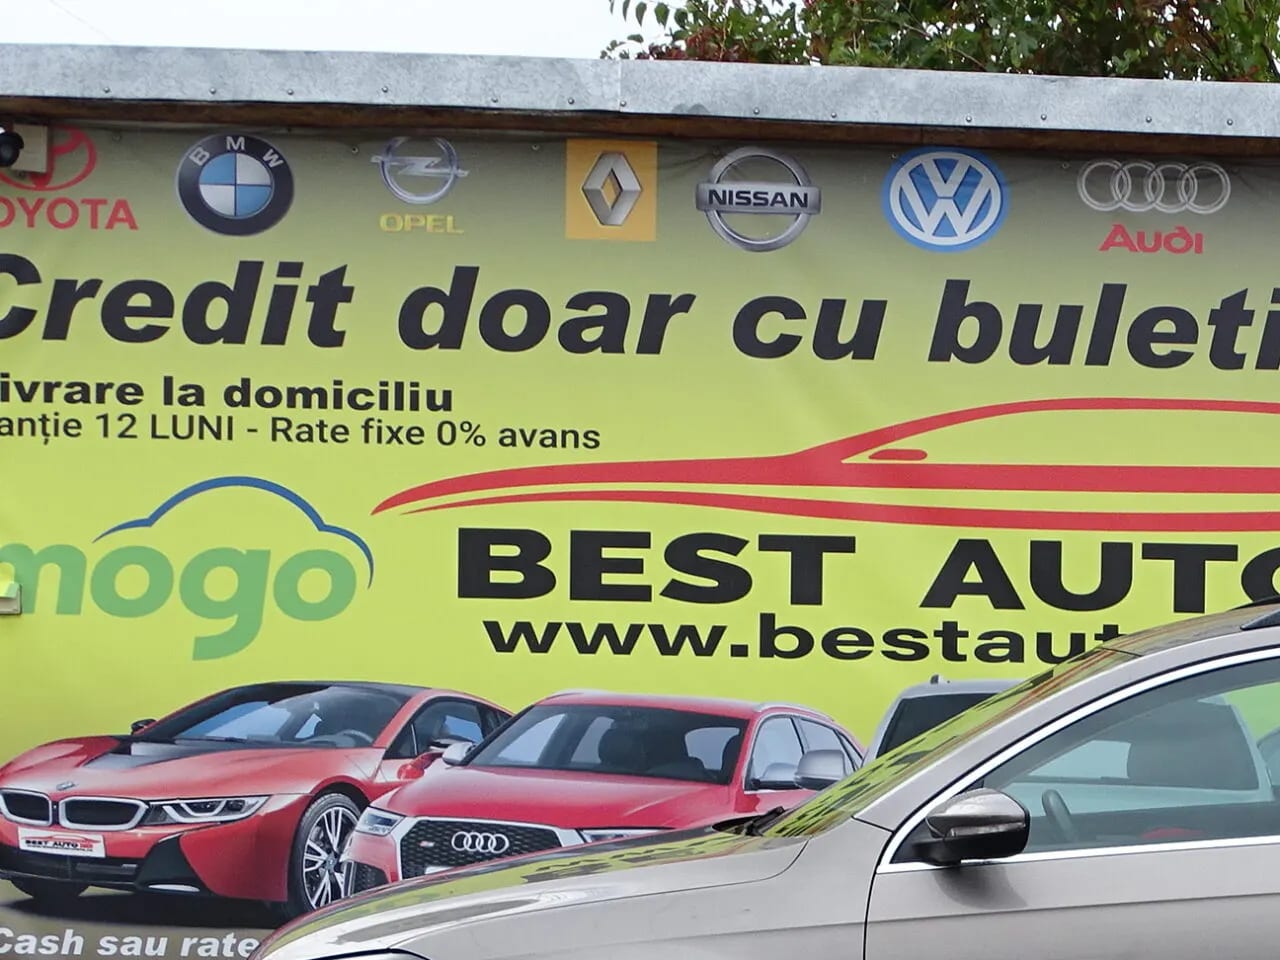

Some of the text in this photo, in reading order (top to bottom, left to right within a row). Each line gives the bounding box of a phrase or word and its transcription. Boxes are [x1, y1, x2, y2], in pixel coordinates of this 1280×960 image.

[188, 135, 284, 169] BMW
[707, 189, 809, 209] NISSAN
[379, 212, 465, 235] OPEL
[1097, 224, 1204, 255] Audi
[397, 265, 697, 356] doar
[731, 295, 888, 361] cu
[0, 372, 453, 412] ivrare la domiciliu
[96, 413, 138, 439] 12
[151, 414, 234, 441] LUNI
[271, 417, 350, 443] Rate
[361, 417, 425, 445] fixe
[437, 420, 486, 447] 0%
[498, 426, 601, 449] avans
[457, 527, 857, 606] BEST
[0, 543, 357, 661] mogo
[97, 936, 169, 957] sau
[180, 931, 260, 958] rate
